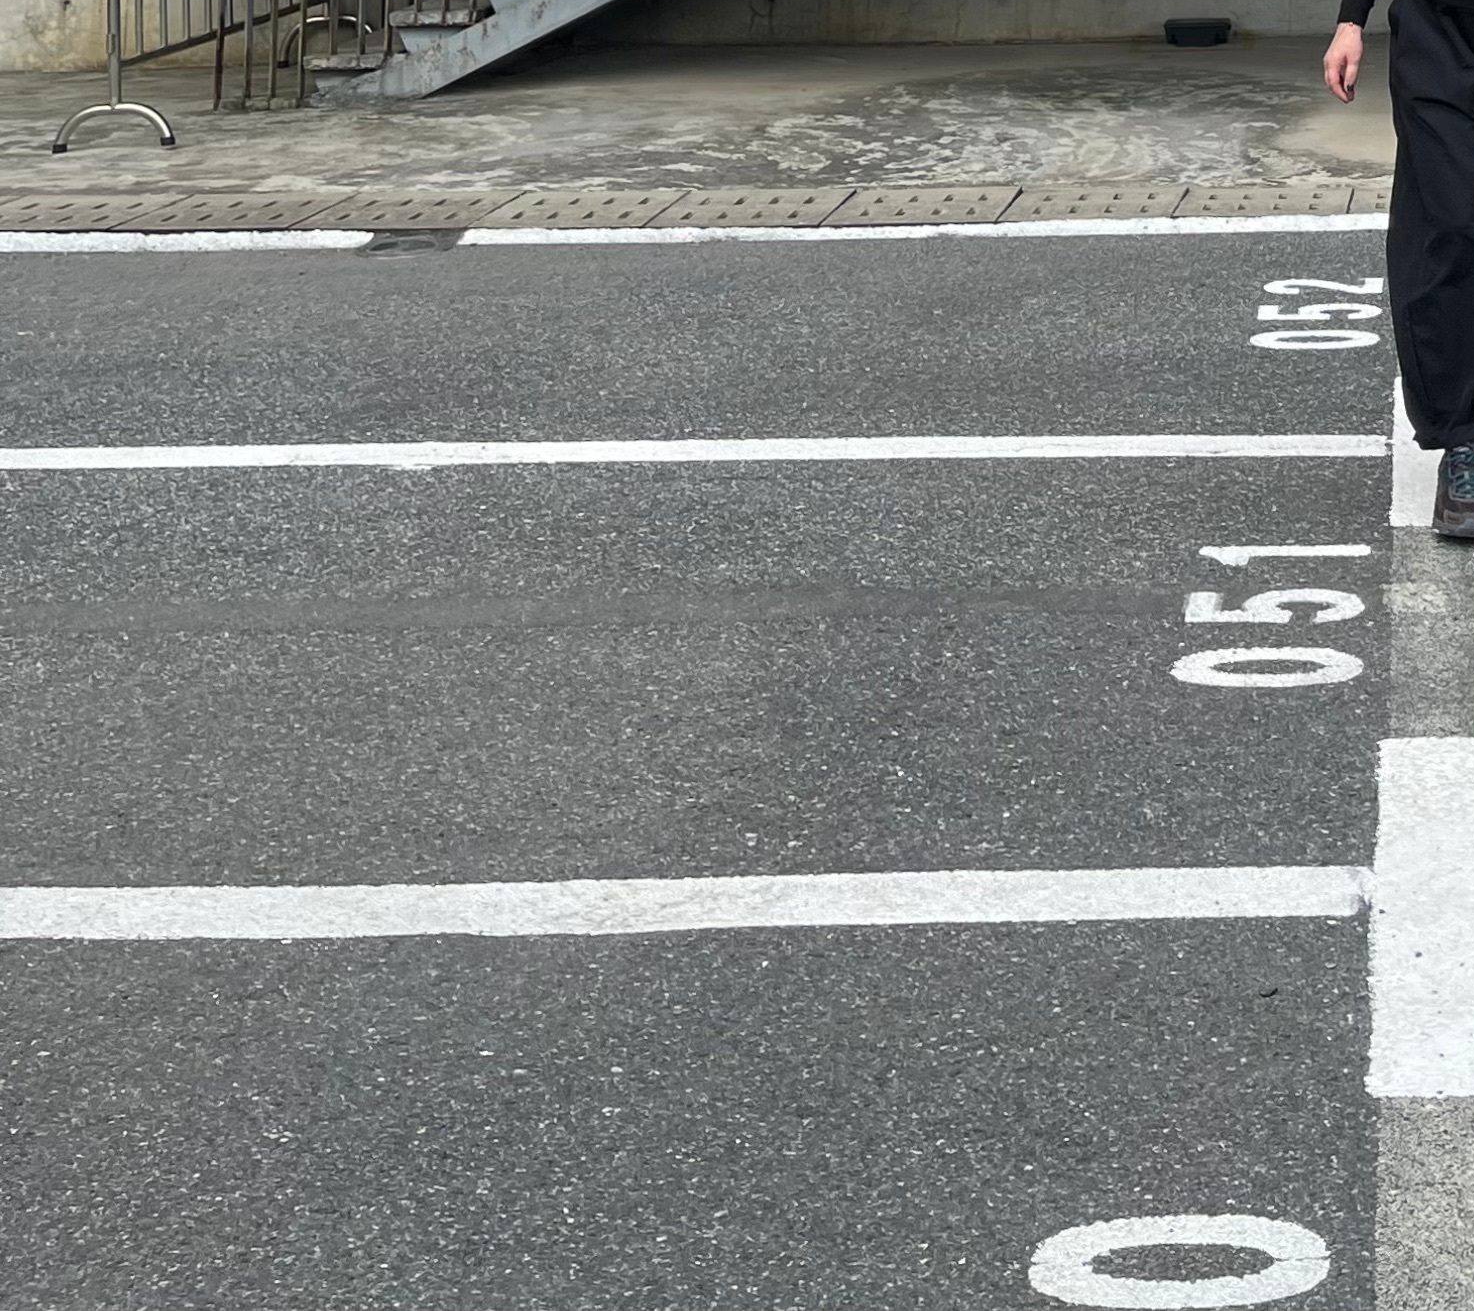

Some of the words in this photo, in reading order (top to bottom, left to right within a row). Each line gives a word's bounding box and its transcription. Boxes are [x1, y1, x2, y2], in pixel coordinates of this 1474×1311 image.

[1249, 276, 1384, 350] 052
[1168, 543, 1372, 688] 051
[1028, 1214, 1331, 1310] 0
